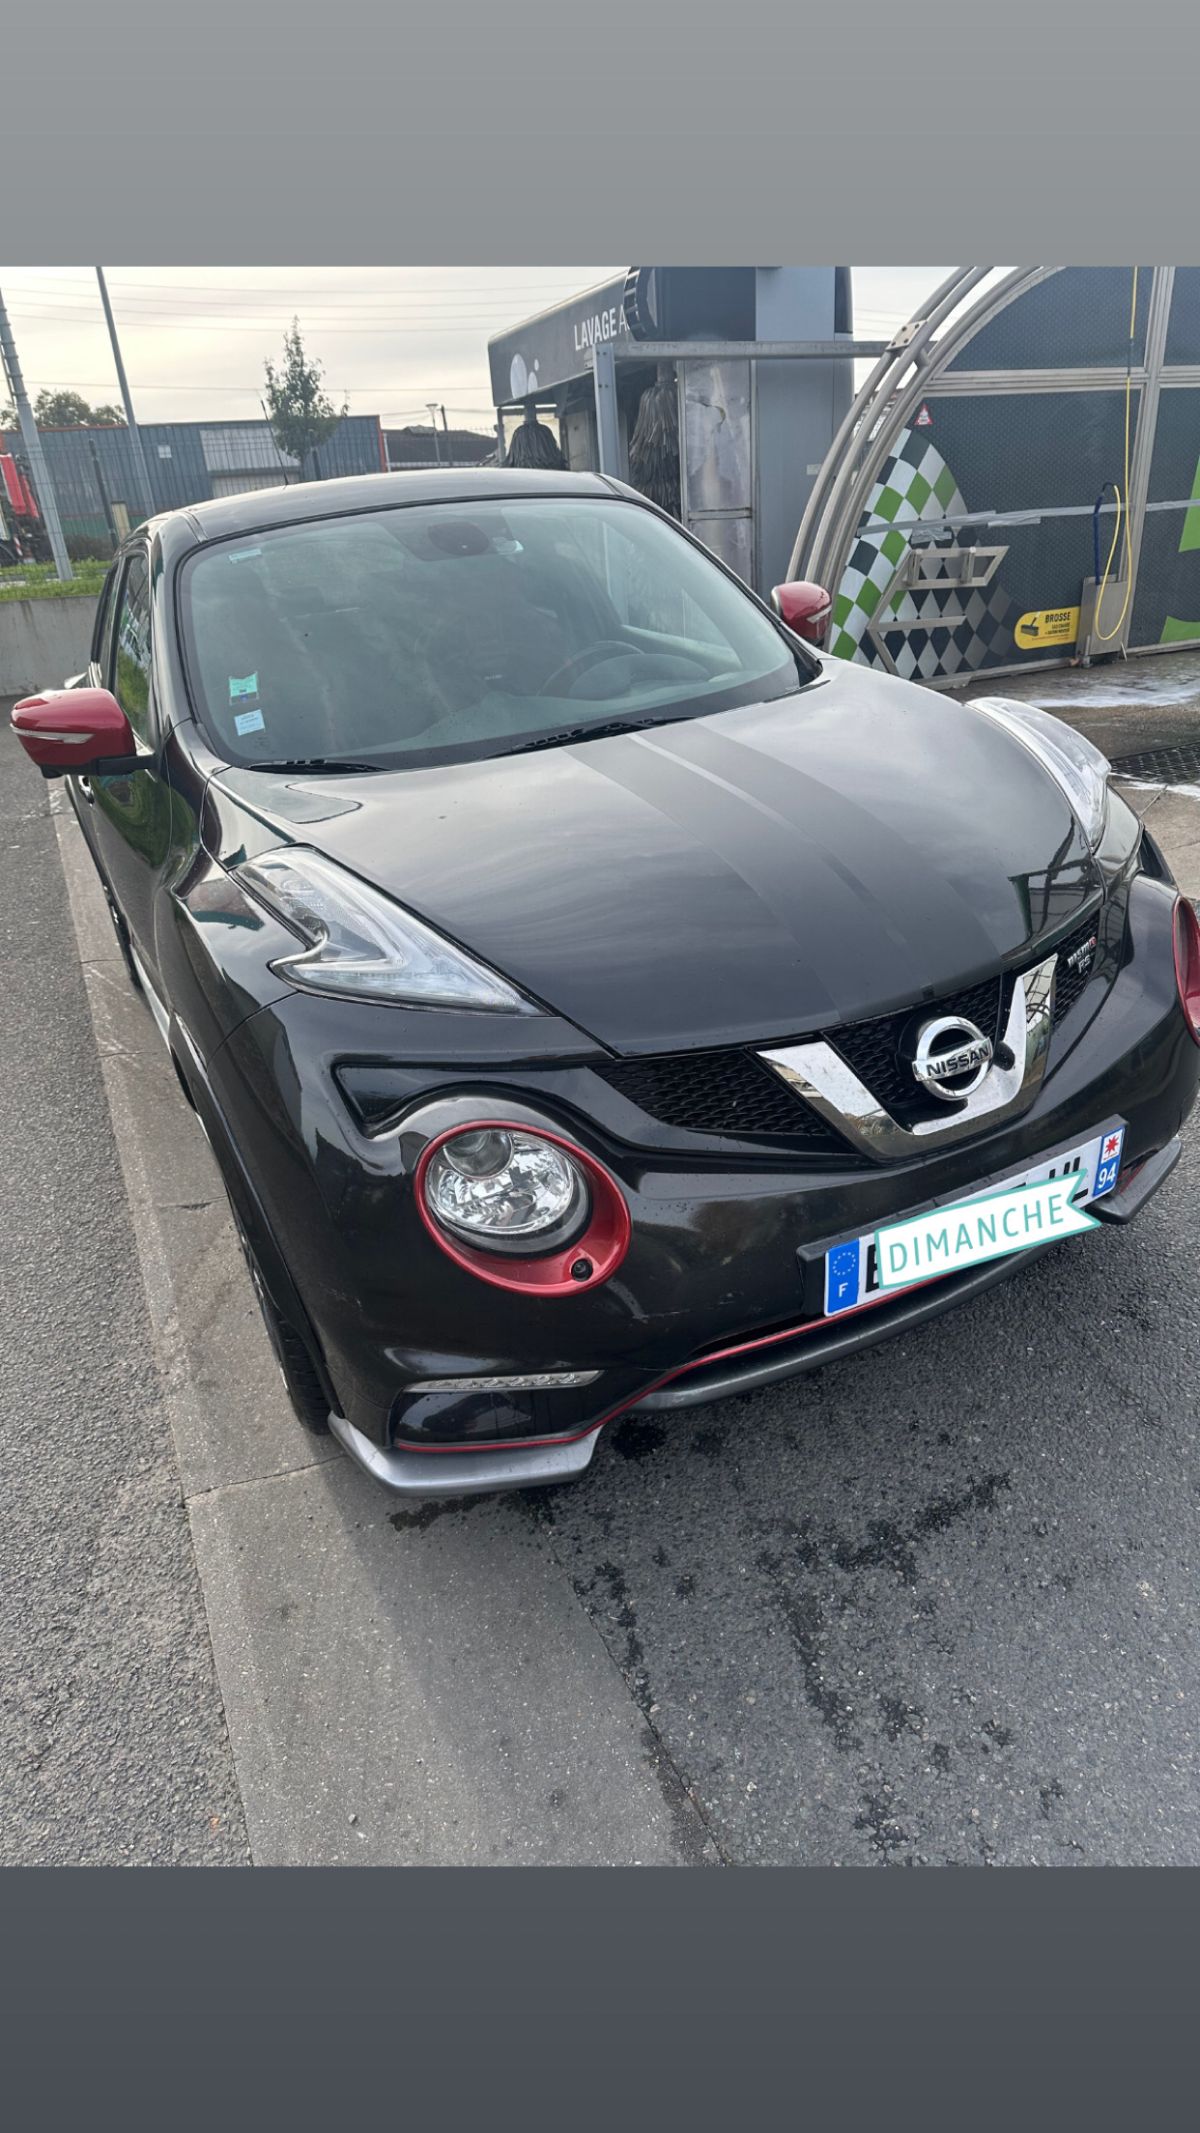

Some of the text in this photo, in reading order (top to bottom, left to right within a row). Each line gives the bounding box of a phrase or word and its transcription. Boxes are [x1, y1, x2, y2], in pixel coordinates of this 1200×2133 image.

[574, 304, 630, 351] LAVAGE A
[1045, 611, 1071, 624] BROSSE
[926, 1046, 990, 1077] NISSAN
[1098, 1162, 1116, 1189] 94
[838, 1283, 848, 1297] F
